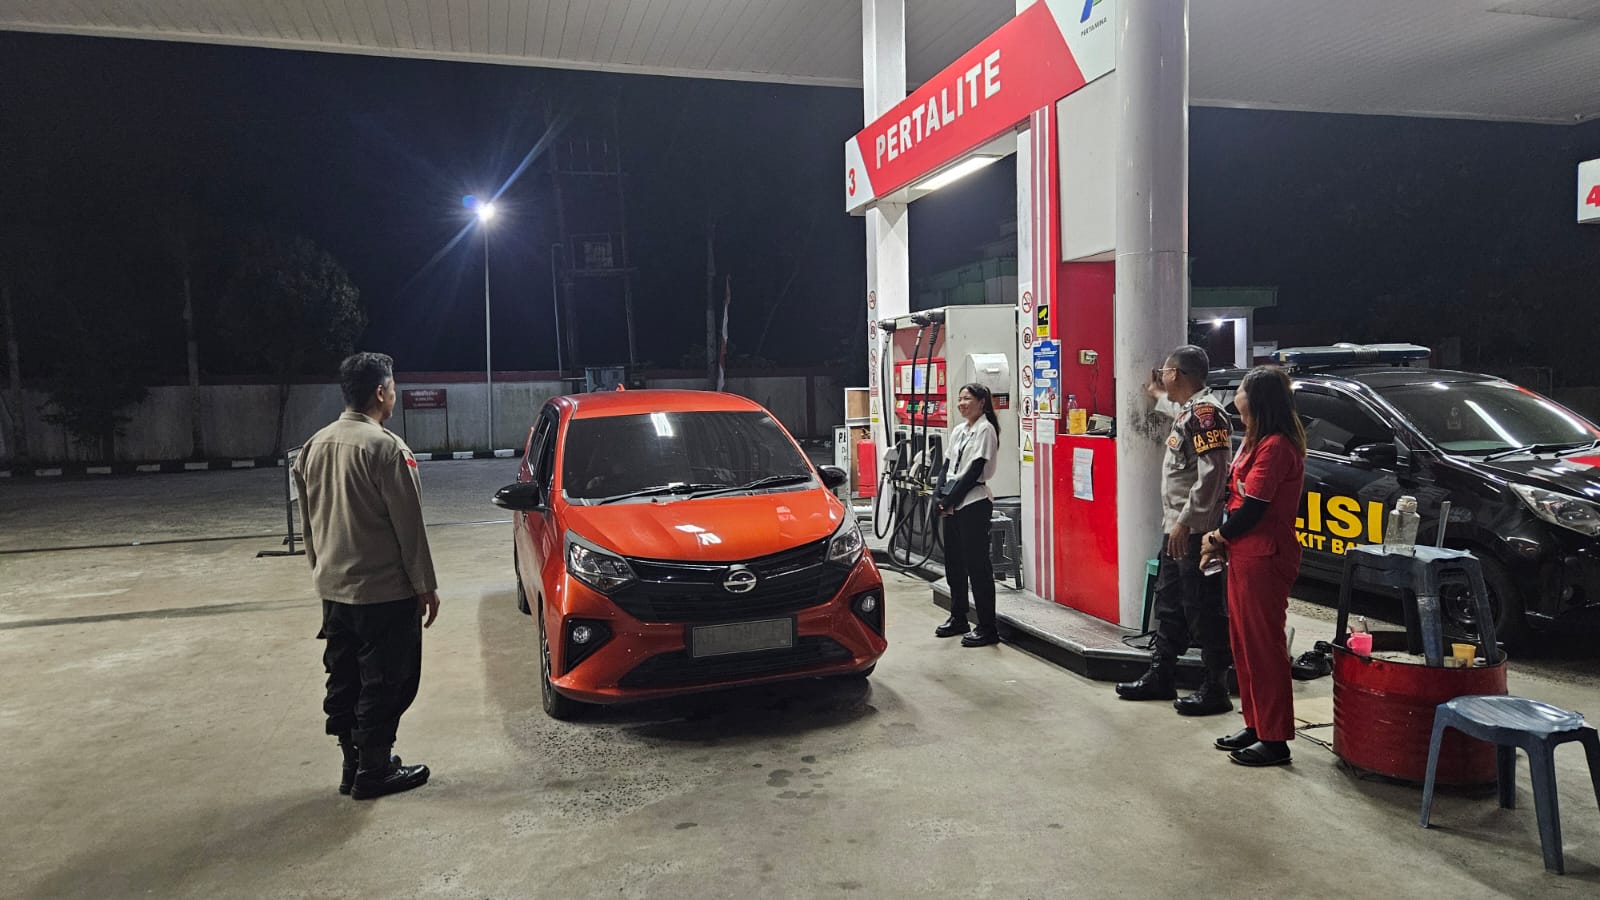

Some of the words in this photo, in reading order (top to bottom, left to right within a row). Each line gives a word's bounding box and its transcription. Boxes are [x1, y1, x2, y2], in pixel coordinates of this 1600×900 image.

[1080, 17, 1107, 36] PERTAMINA
[876, 49, 1001, 169] PERTALITE
[848, 168, 856, 196] 3
[1586, 184, 1600, 207] 4
